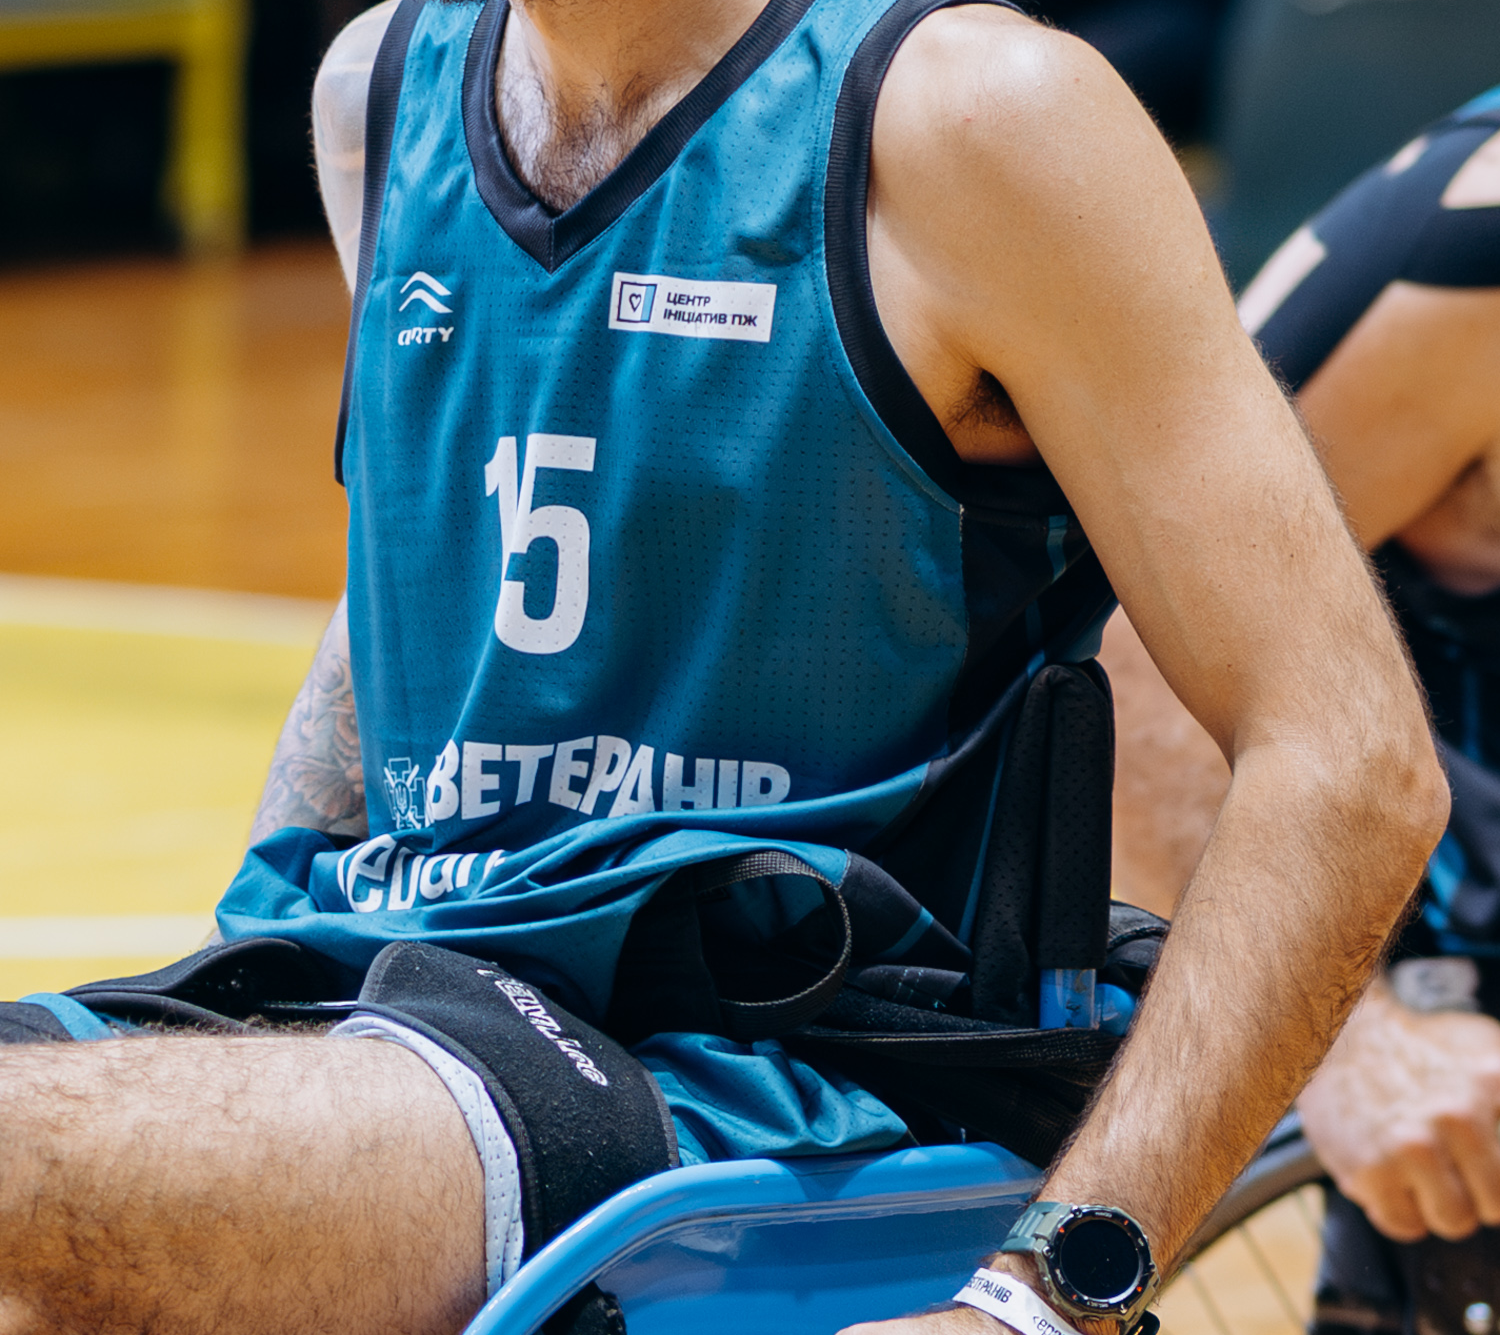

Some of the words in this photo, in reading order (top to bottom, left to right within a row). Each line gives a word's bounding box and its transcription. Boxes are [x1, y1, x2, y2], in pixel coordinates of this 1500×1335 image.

[666, 291, 712, 307] ЦЕНТР
[663, 308, 728, 325] ІНІЦІАТИВ
[731, 313, 758, 328] ПЖ
[484, 433, 597, 655] 15
